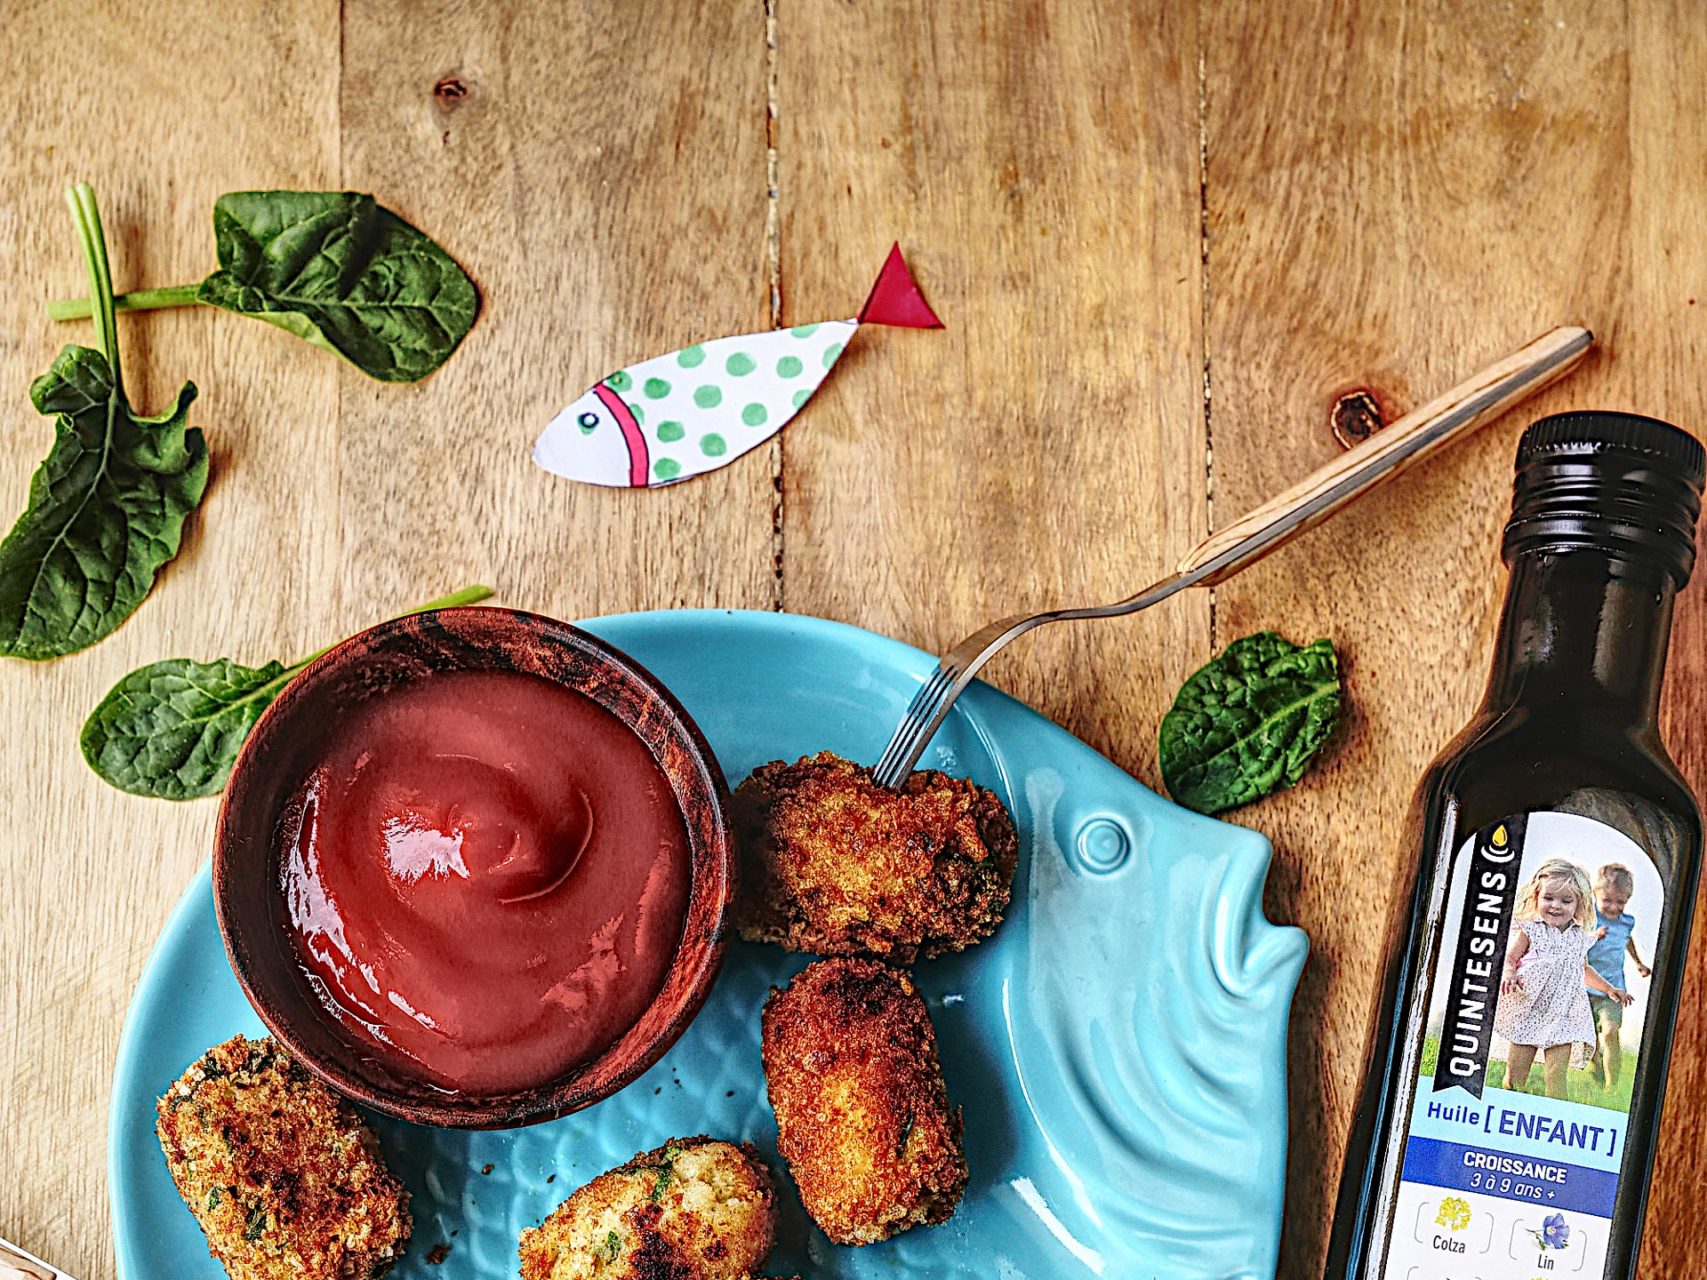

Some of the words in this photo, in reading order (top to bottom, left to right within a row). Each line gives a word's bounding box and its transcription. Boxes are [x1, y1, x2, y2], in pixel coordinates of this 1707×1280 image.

[1450, 871, 1506, 1077] QUINTESENS
[1427, 1101, 1480, 1125] Huile
[1463, 1151, 1567, 1184] CROISSANCE
[1470, 1172, 1483, 1187] 3
[1485, 1174, 1495, 1190] à
[1499, 1178, 1510, 1192] 9
[1514, 1183, 1542, 1199] ans
[1432, 1235, 1466, 1254] Colza
[1538, 1254, 1554, 1270] Lin
